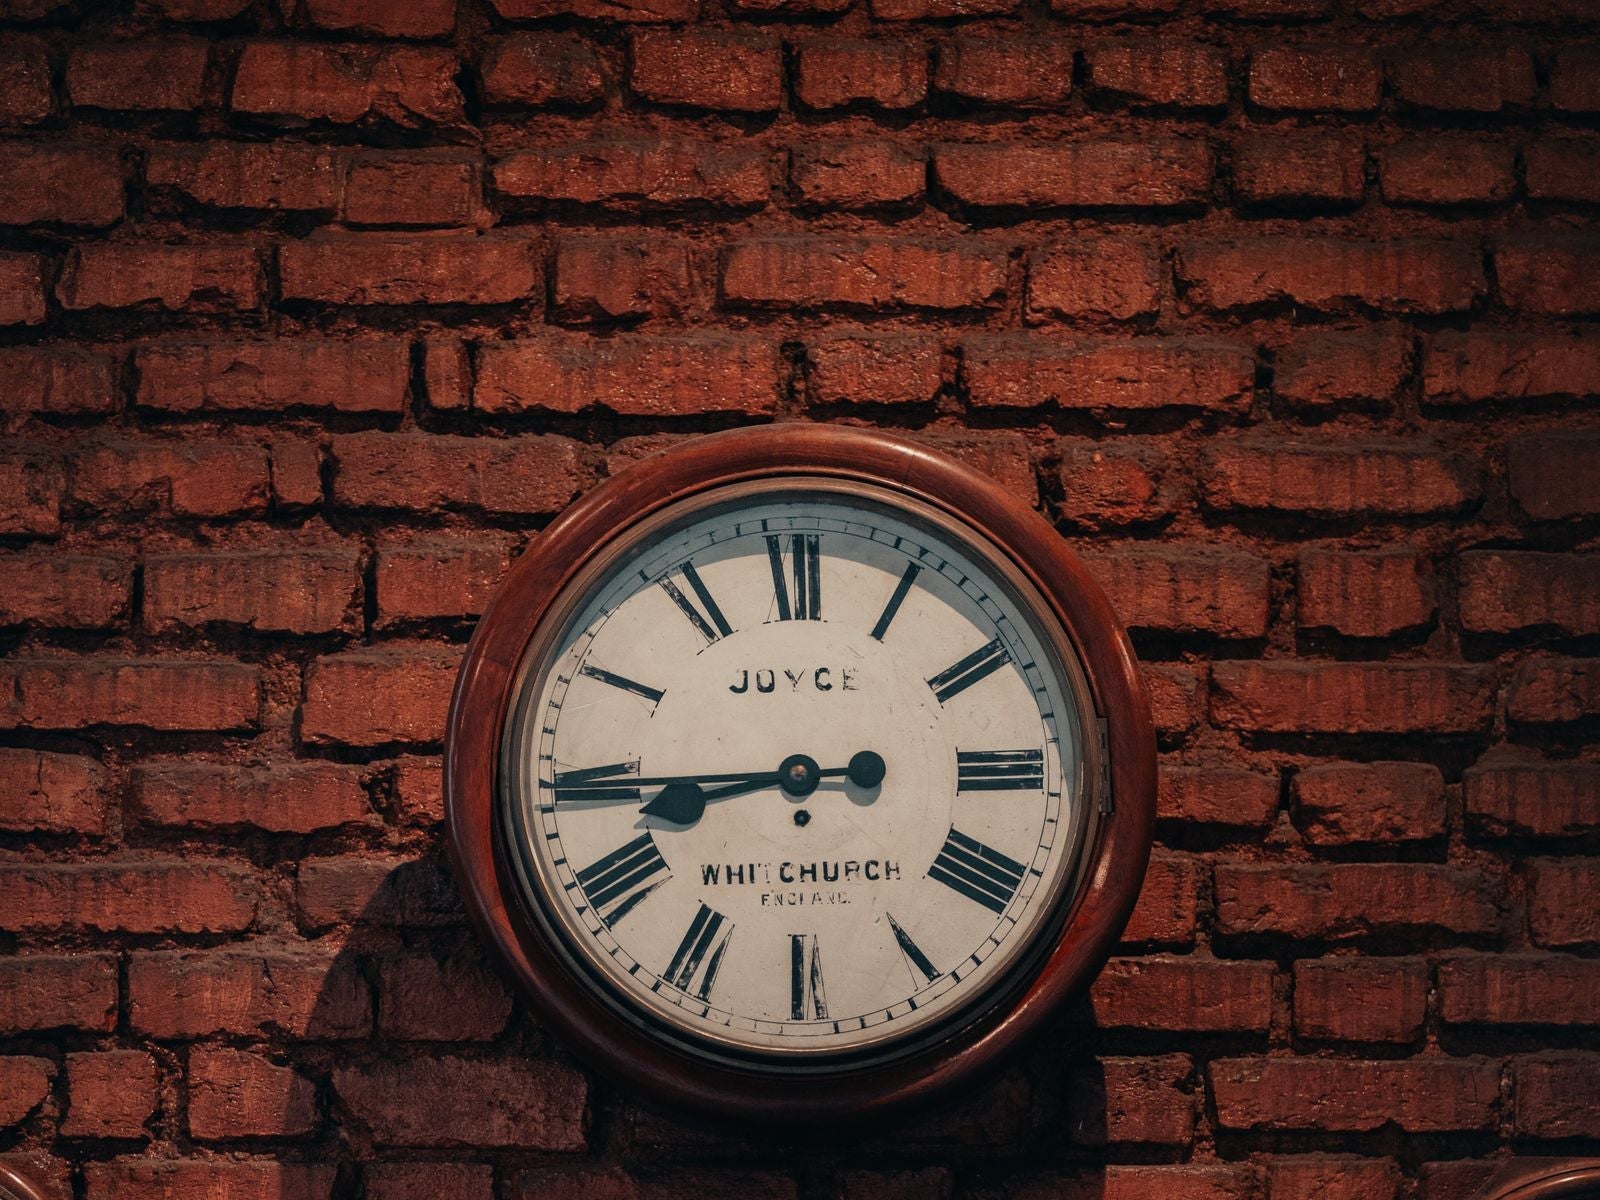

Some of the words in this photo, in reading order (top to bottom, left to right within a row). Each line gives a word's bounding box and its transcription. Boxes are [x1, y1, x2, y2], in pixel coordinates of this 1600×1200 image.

[763, 533, 827, 623] XII
[871, 561, 924, 643] I
[729, 668, 860, 693] JOYCE
[925, 635, 1014, 708] II
[956, 747, 1044, 795] III
[702, 860, 901, 885] WHITCHURCH
[788, 934, 829, 1020] VI
